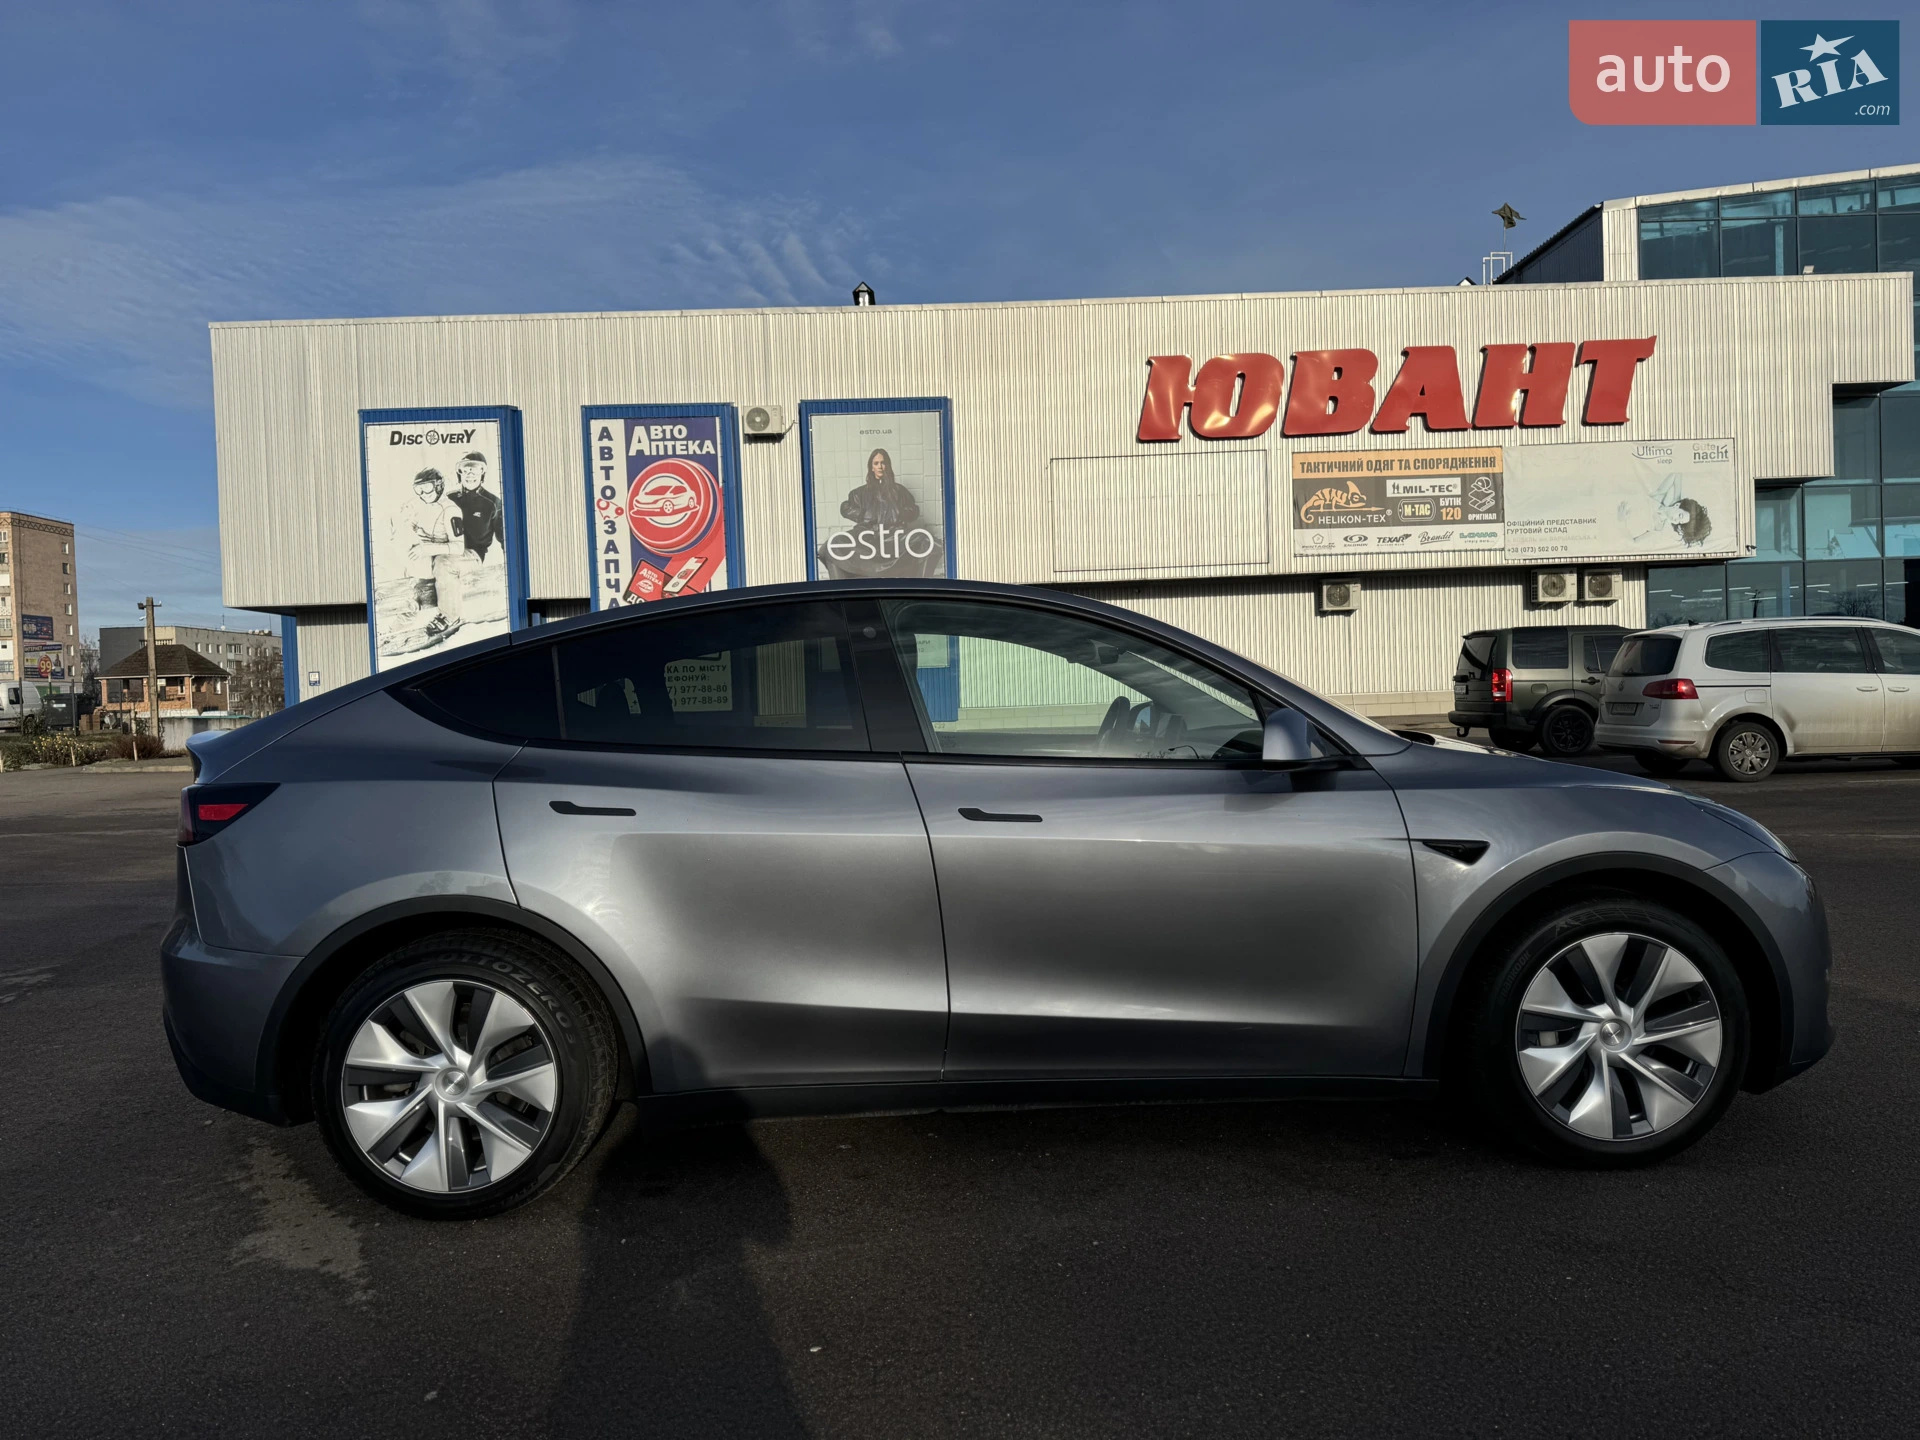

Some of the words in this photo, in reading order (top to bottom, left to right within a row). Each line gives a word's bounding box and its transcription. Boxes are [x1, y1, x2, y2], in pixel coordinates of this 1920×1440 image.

[1137, 335, 1657, 442] ЮВАНТ
[859, 428, 893, 436] estro.ua
[1636, 445, 1673, 456] Ultima
[1692, 443, 1716, 451] Gute
[1693, 445, 1729, 460] nacht
[1299, 458, 1364, 474] ТАКТИЧНИЙ
[1366, 459, 1395, 473] ОДЯГ
[1397, 458, 1411, 471] ТА
[1413, 456, 1496, 471] СПОРЯДЖЕННЯ
[1440, 497, 1462, 506] БУТІК
[1440, 507, 1462, 520] 120
[1506, 519, 1545, 527] ОФІЦІЙНИЙ
[1546, 518, 1597, 526] ПРЕДСТАВНИК
[1506, 527, 1542, 535] ГУРТОВИЙ
[826, 523, 935, 561] estro
[1377, 536, 1405, 544] TEXAR
[1520, 546, 1536, 554] (073)
[40, 660, 52, 673] 99
[682, 665, 696, 673] ПО
[699, 664, 727, 672] МІСТУ
[680, 685, 728, 694] 977-88-80
[680, 696, 729, 705] 977-88-89
